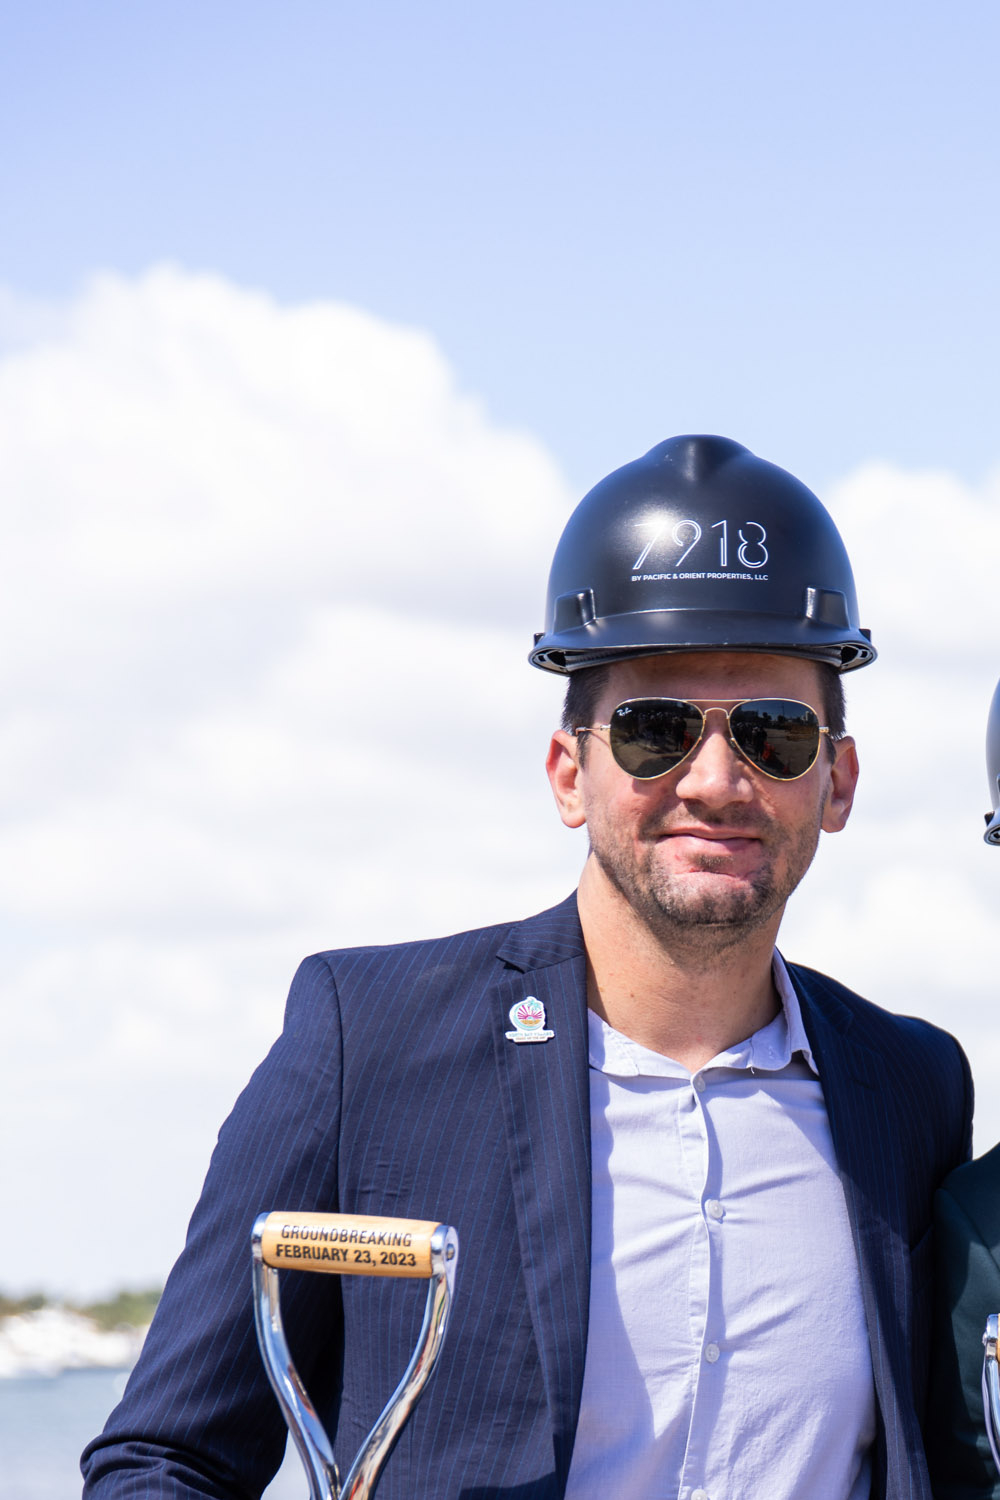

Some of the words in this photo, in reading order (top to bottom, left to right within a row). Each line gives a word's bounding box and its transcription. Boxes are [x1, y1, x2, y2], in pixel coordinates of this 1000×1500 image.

[632, 519, 769, 570] 7918
[643, 573, 671, 581] PACIFIC
[707, 573, 754, 581] PROPERTIES,
[281, 1224, 412, 1247] GROUNDBREAKING
[276, 1244, 349, 1262] FEBRUARY
[353, 1250, 376, 1267] 23,
[380, 1251, 417, 1267] 2023
